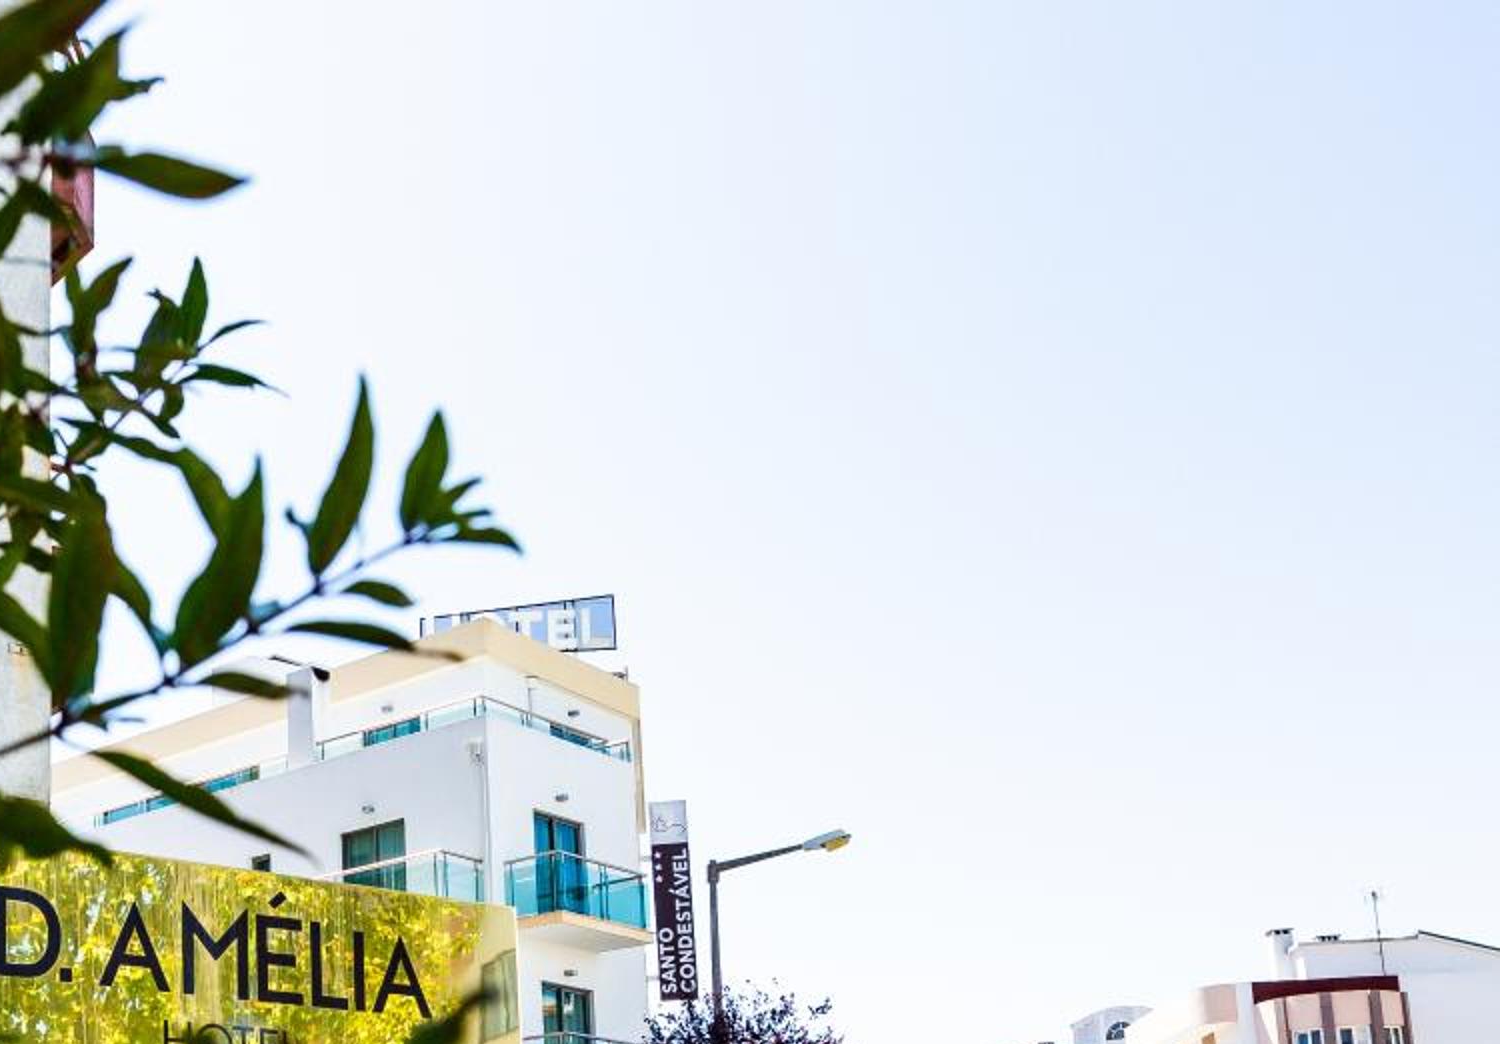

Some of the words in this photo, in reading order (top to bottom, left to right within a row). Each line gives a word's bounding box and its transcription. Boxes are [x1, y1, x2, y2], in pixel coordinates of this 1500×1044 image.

[421, 606, 609, 651] TEL
[99, 891, 432, 1019] AMÉLIA
[659, 926, 678, 994] SANTO
[669, 848, 697, 993] CONDESTÁVEL
